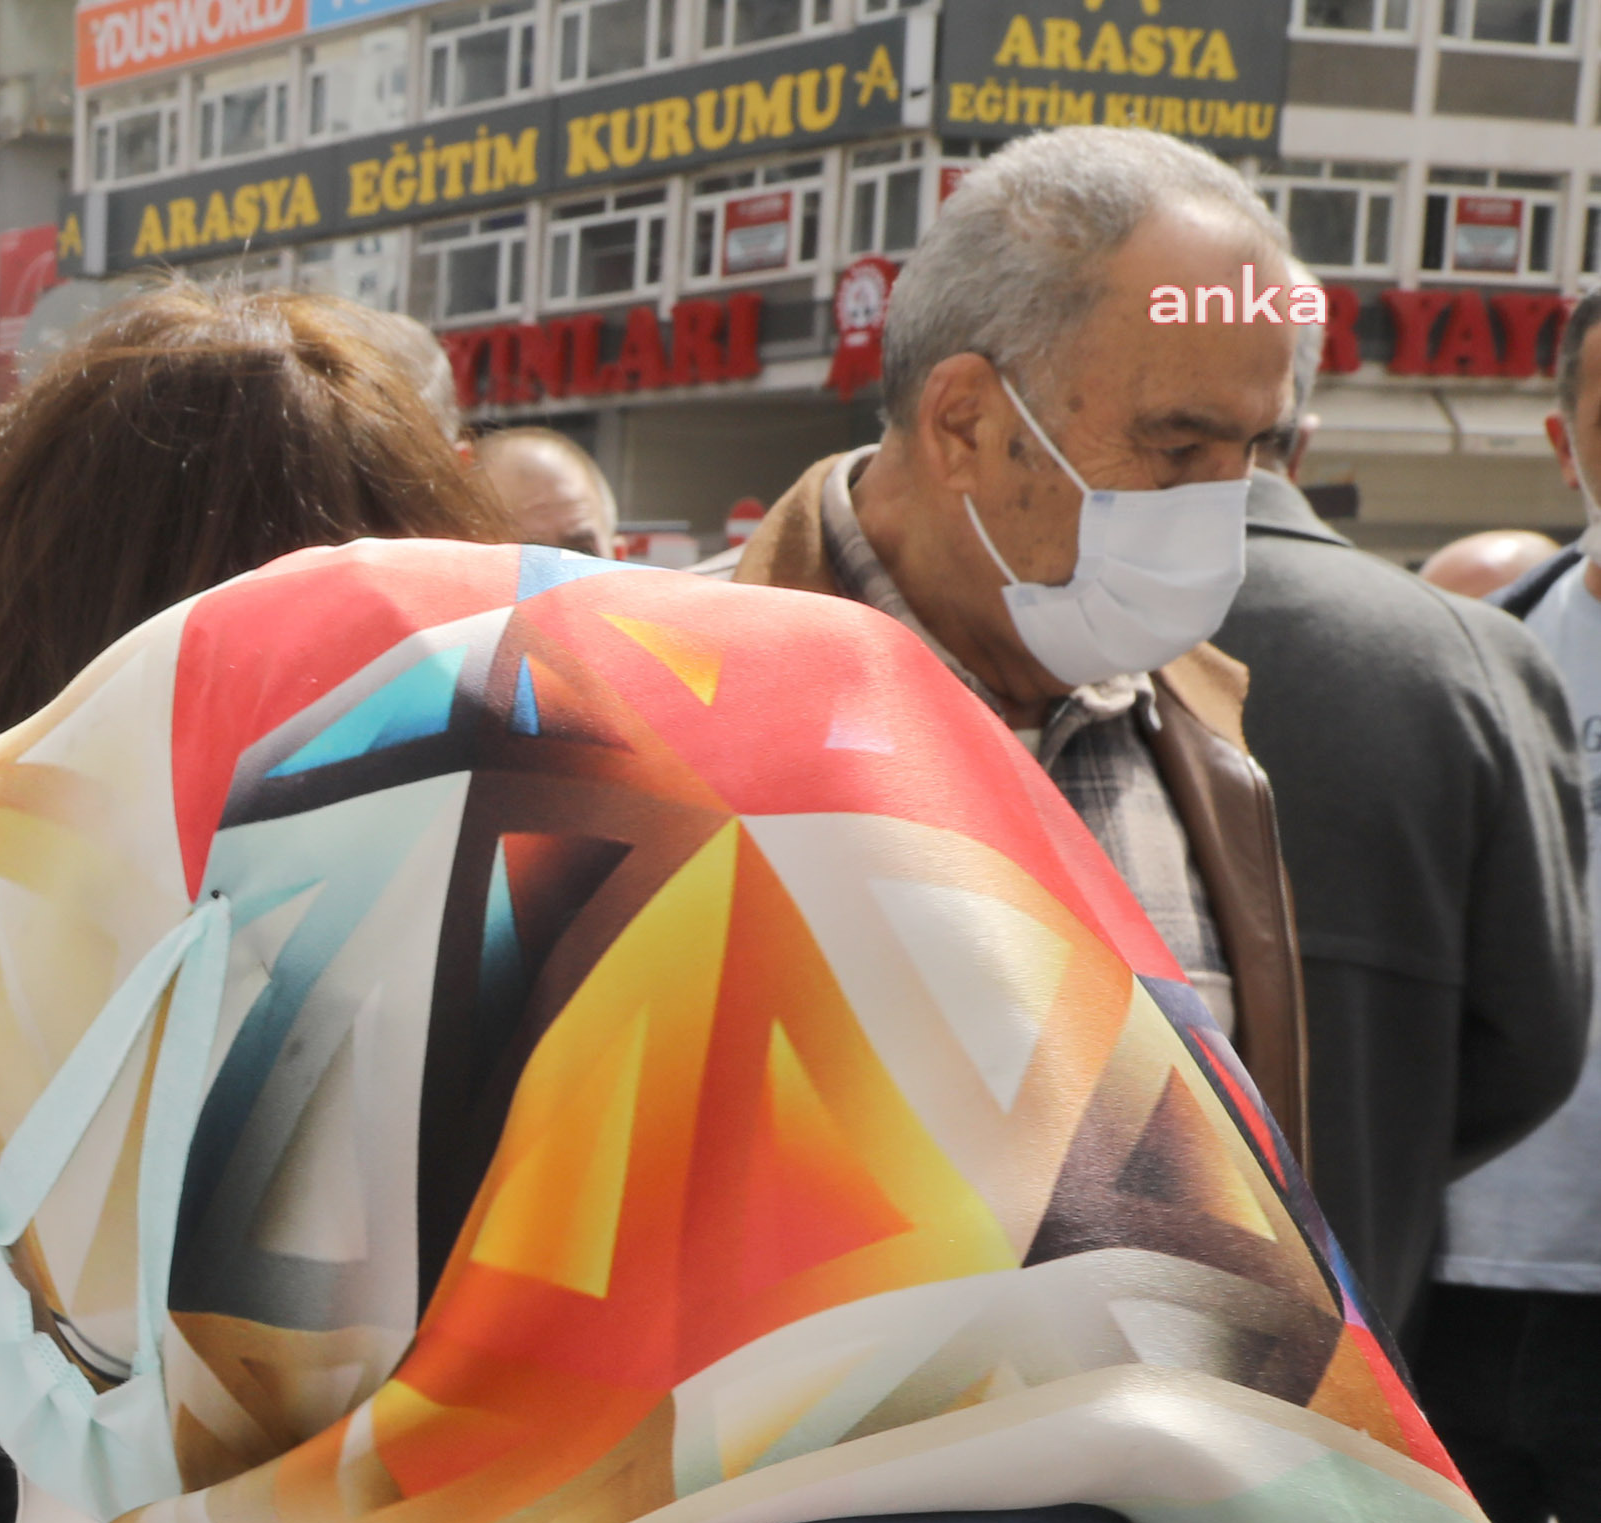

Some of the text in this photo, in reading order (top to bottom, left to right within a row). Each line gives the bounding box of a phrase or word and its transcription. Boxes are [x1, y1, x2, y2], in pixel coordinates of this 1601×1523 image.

[994, 14, 1238, 81] ARASYA
[948, 76, 1276, 140] EĞİTİM KURUMU
[134, 66, 845, 256] ARASYA EĞİTİM KURUMU
[1381, 287, 1580, 378] YAY
